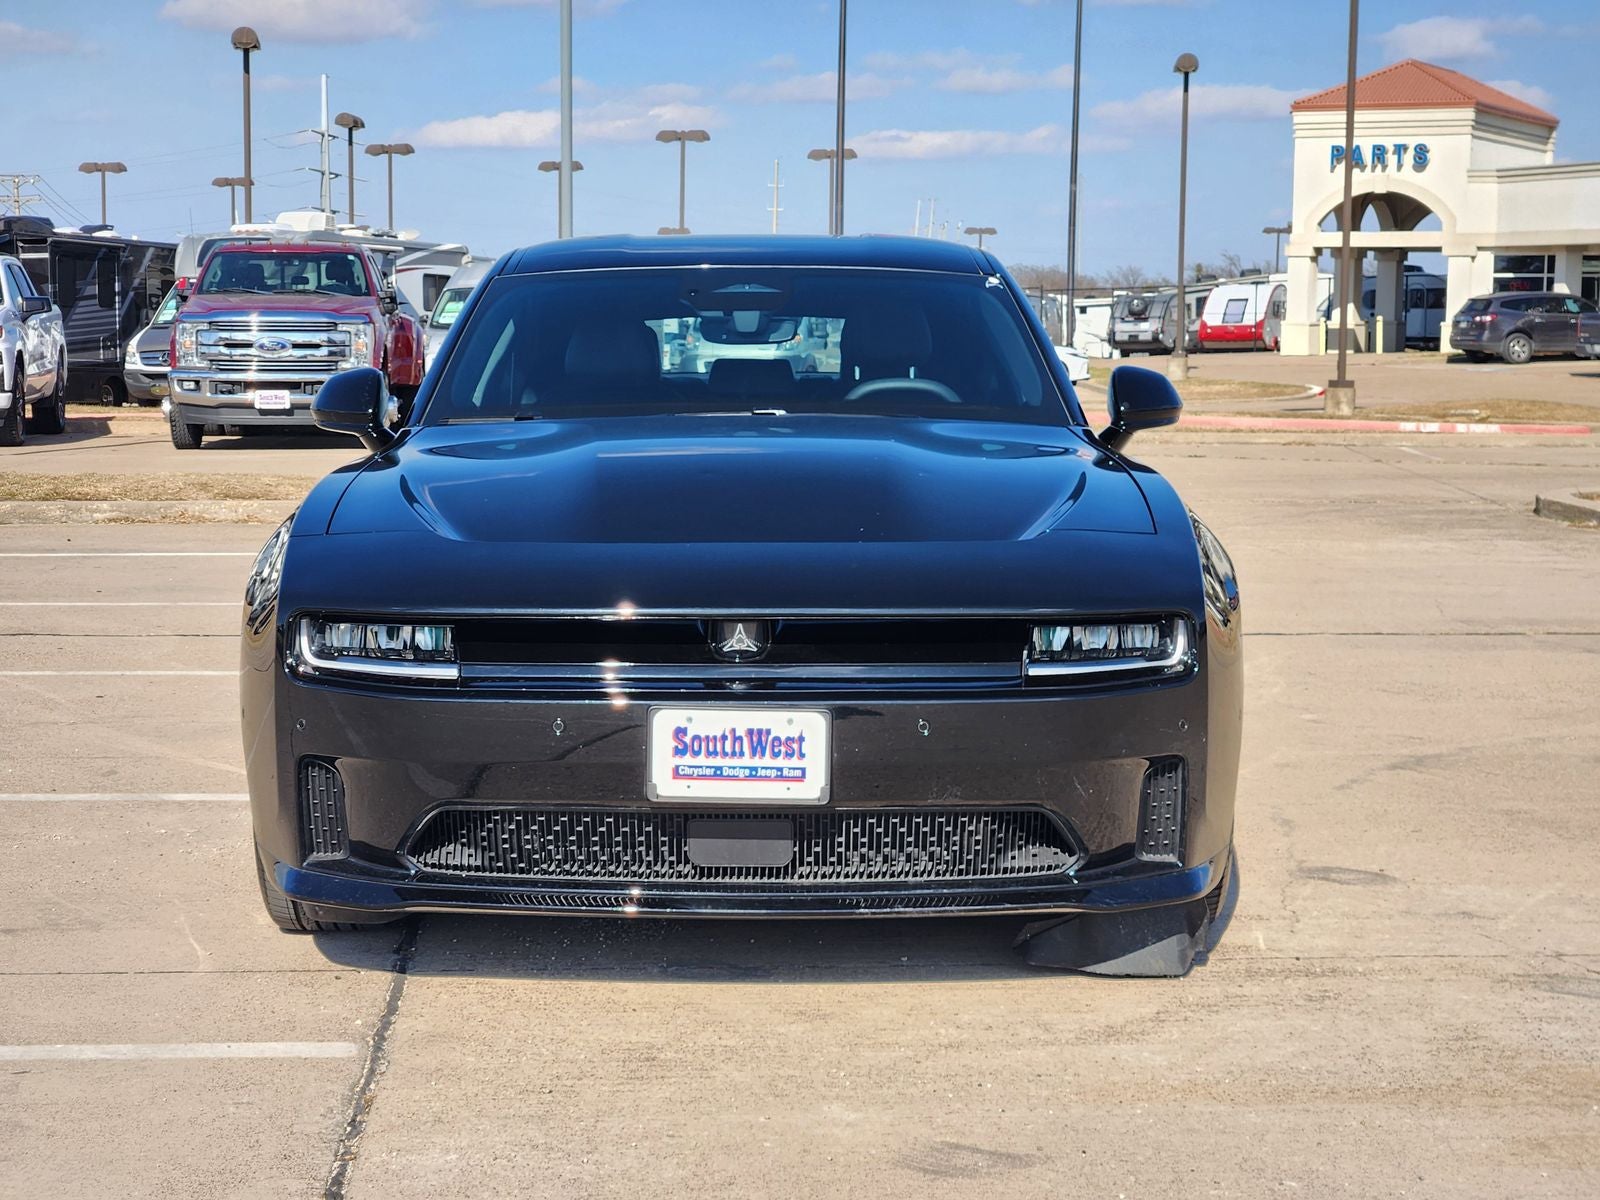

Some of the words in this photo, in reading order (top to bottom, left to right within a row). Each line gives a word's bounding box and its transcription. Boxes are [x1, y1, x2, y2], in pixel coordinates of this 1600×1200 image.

[1330, 143, 1430, 168] PARTS
[678, 765, 715, 777] Chrysler
[722, 766, 750, 778] Dodge
[756, 767, 777, 778] Jeep
[783, 767, 802, 777] Ram
